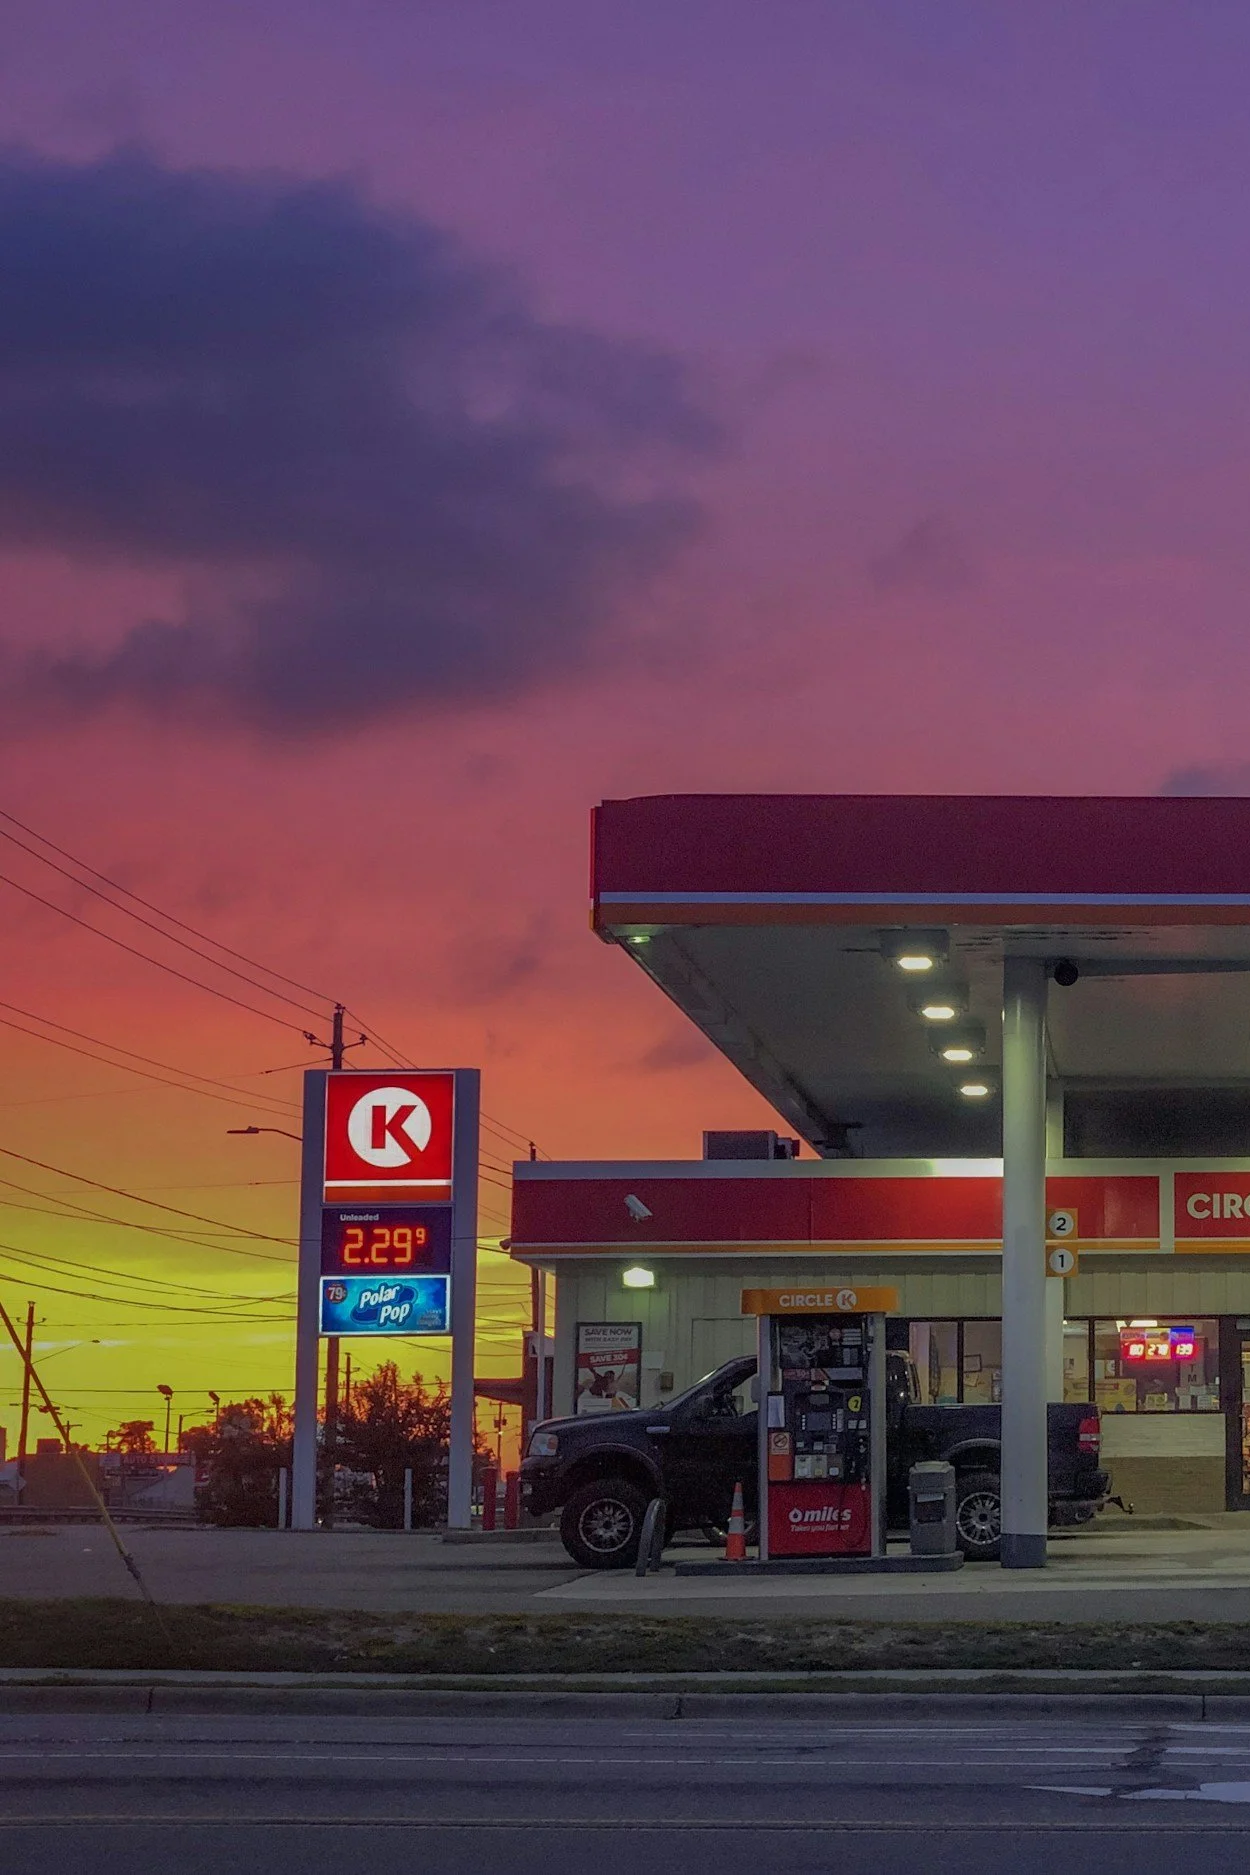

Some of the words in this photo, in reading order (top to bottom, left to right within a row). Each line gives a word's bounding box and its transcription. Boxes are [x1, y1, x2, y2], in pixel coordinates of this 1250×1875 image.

[371, 1105, 422, 1161] K
[1056, 1217, 1066, 1231] 2
[1058, 1254, 1065, 1268] 1
[360, 1285, 400, 1309] Polar
[780, 1294, 833, 1307] CIRCLE
[380, 1304, 410, 1324] Pop
[589, 1355, 612, 1363] SAVE
